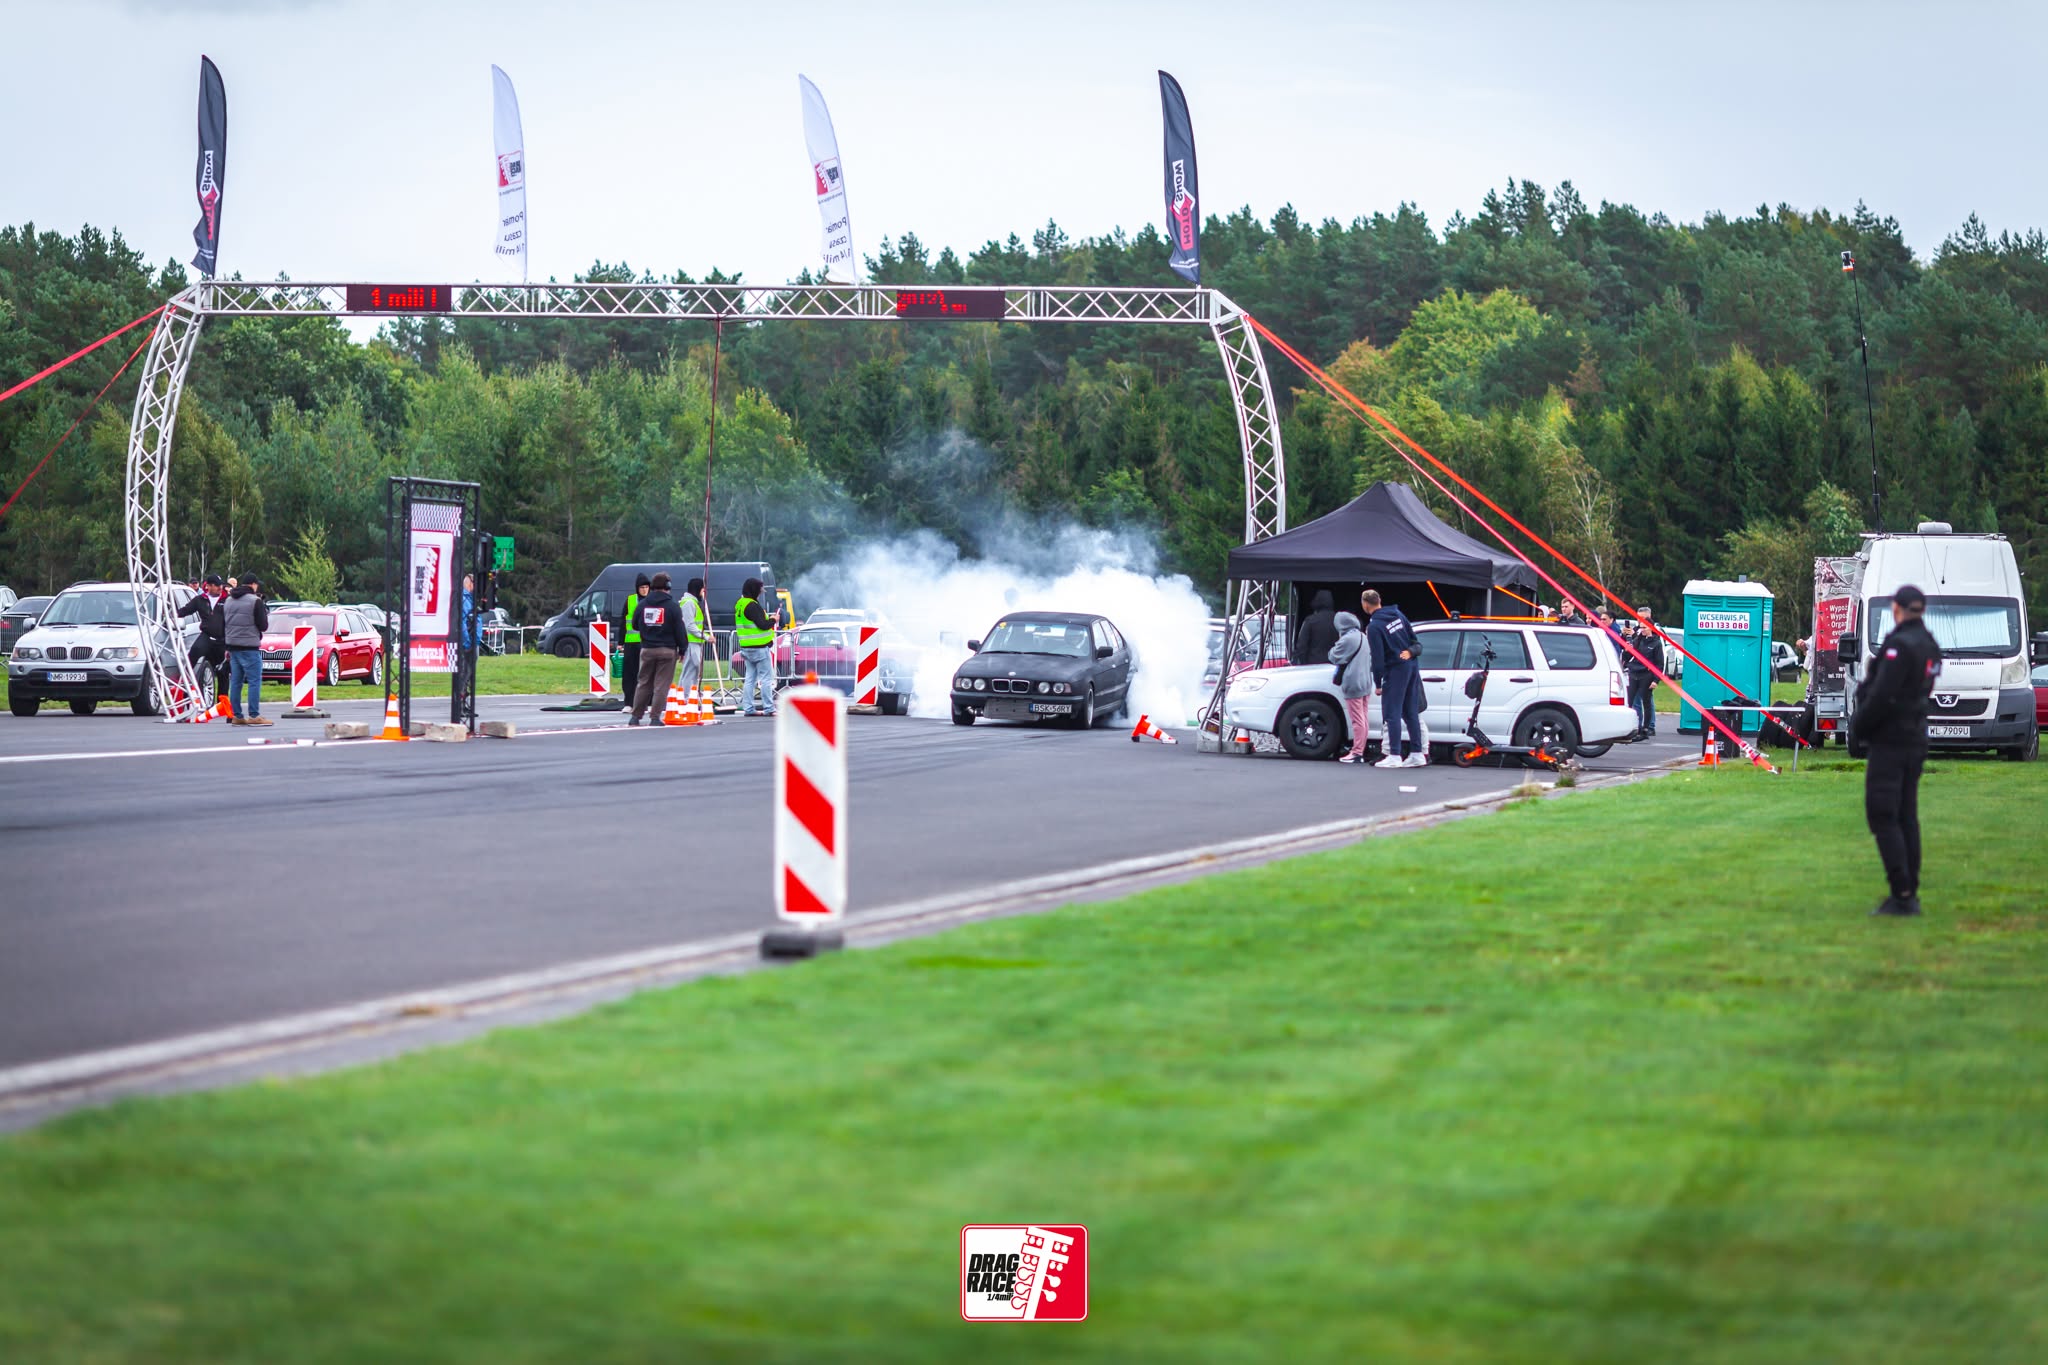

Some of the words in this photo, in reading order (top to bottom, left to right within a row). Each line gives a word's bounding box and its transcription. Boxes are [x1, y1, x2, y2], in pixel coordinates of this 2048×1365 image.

[388, 287, 425, 307] mili
[1700, 613, 1748, 621] WCSERWIS.PL
[1700, 621, 1714, 629] 801
[1732, 622, 1748, 630] 088
[65, 673, 86, 681] 19936
[1035, 704, 1050, 712] BSK
[1052, 704, 1071, 713] 56RY
[1930, 726, 1941, 735] WL
[1943, 726, 1969, 735] 7909U
